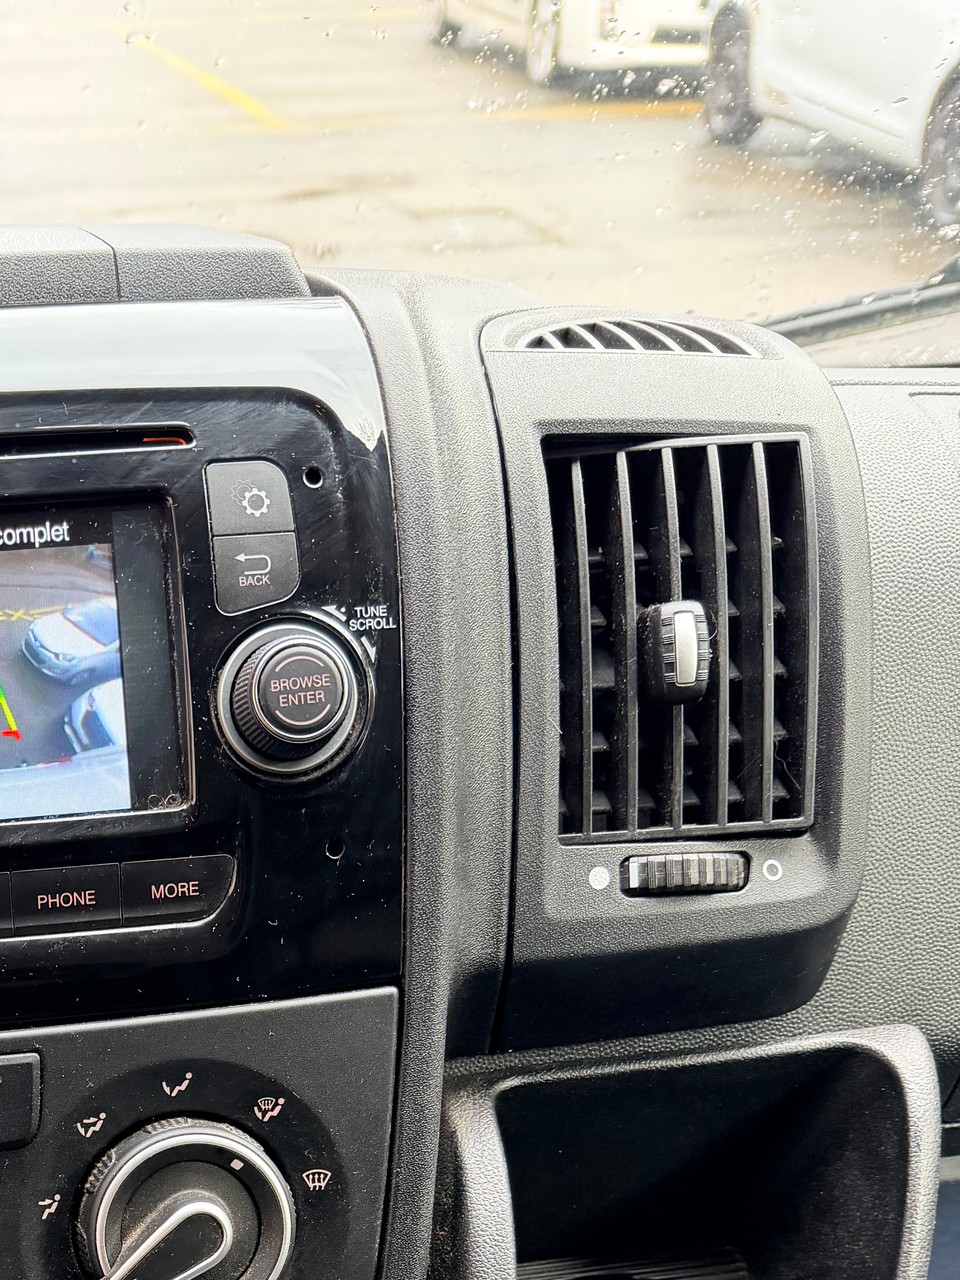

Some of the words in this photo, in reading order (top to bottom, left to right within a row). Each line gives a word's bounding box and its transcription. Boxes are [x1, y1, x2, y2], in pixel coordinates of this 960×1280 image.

[238, 574, 271, 587] BACK
[354, 605, 388, 618] TUNE
[349, 617, 397, 631] SCROLL
[270, 674, 331, 691] BROWSE
[278, 690, 326, 707] ENTER
[150, 881, 200, 899] MORE
[37, 889, 96, 909] PHONE
